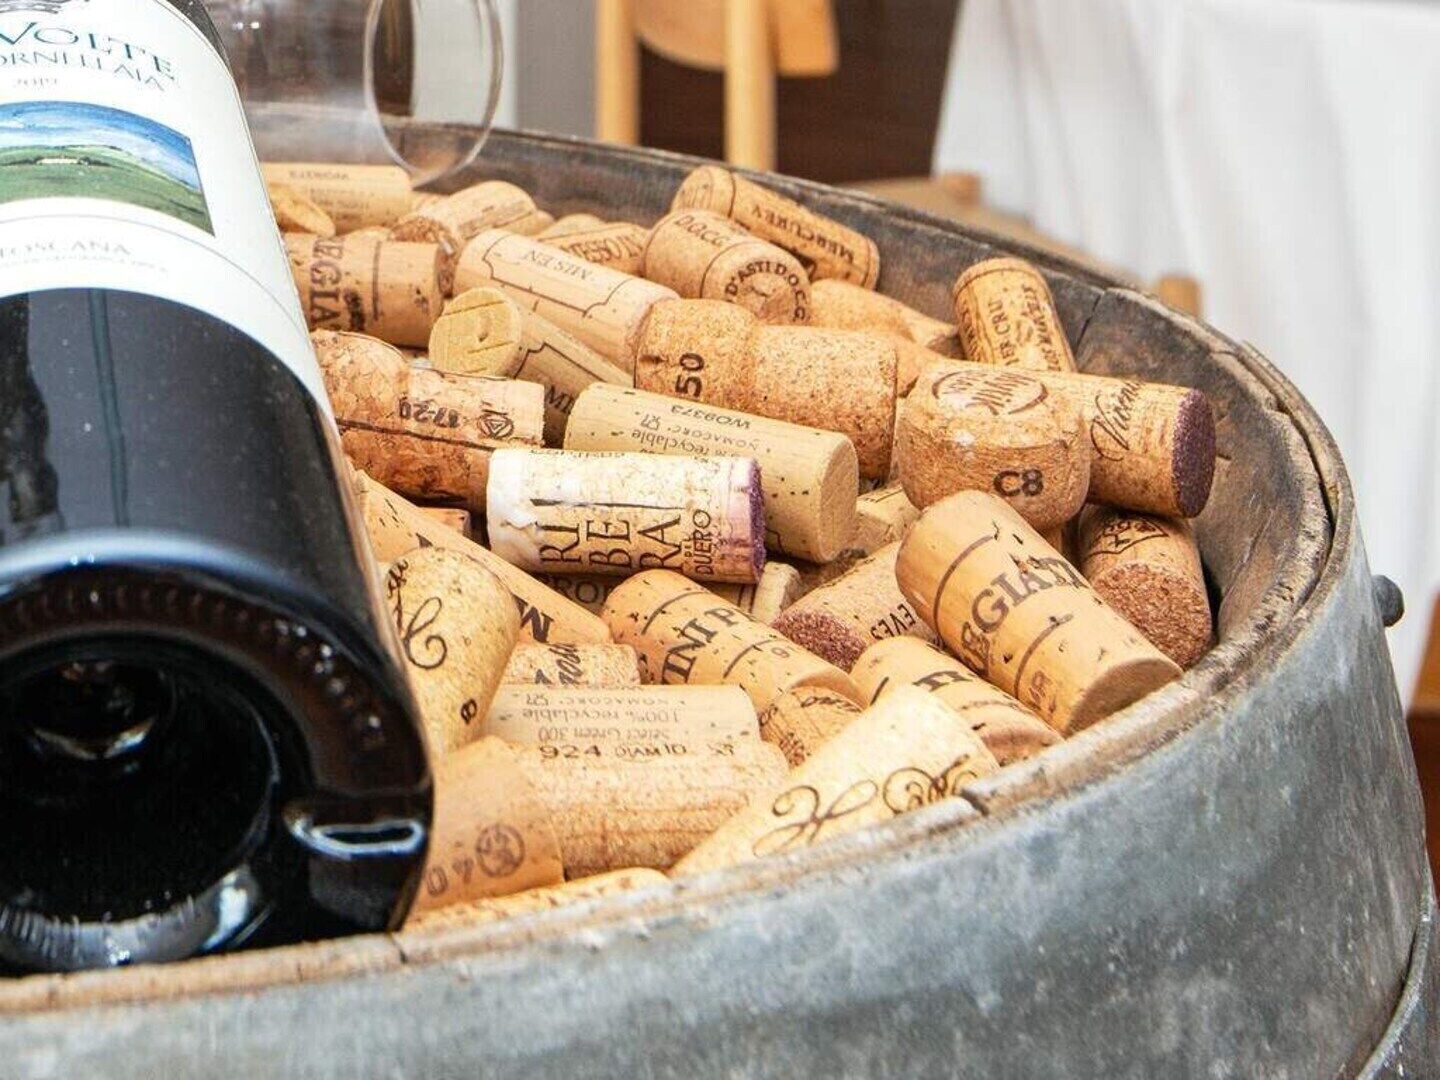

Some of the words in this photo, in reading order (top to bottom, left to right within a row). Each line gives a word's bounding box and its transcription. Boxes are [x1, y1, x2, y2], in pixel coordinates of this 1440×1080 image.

[749, 204, 856, 263] MERCUREY
[675, 352, 705, 398] 50
[631, 430, 711, 457] recyclable
[586, 519, 632, 569] BE
[638, 513, 685, 571] RA
[693, 508, 712, 574] DUERO
[539, 745, 602, 759] 924
